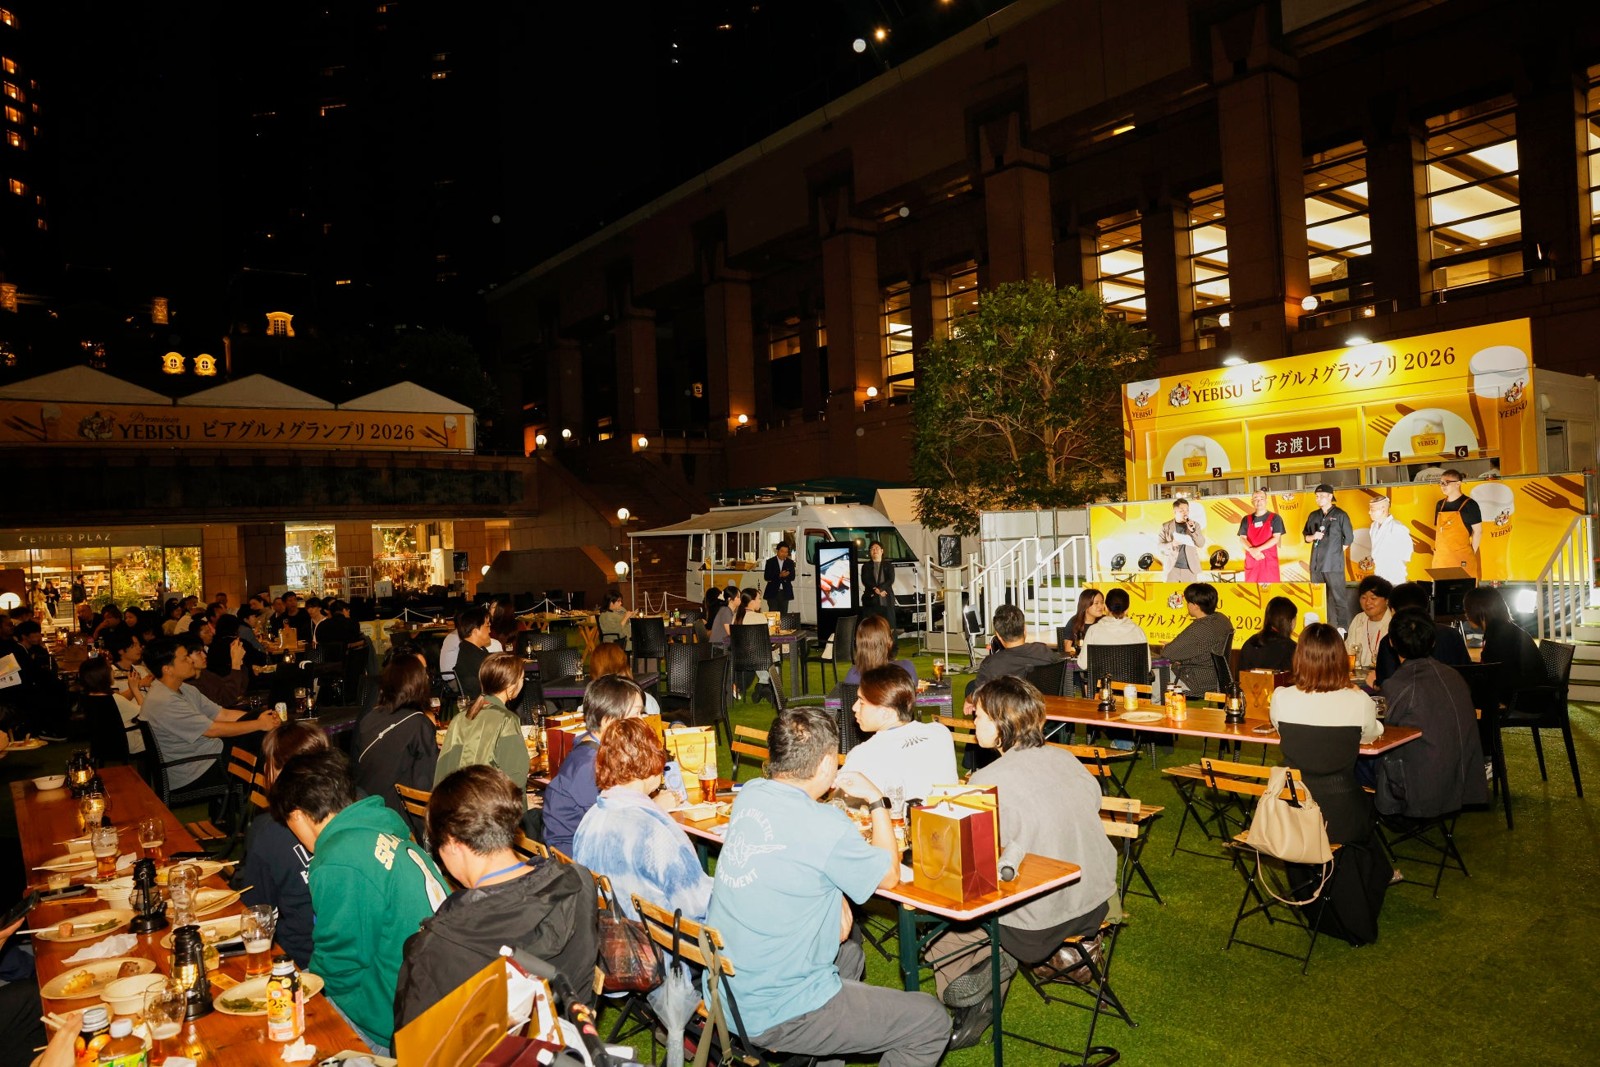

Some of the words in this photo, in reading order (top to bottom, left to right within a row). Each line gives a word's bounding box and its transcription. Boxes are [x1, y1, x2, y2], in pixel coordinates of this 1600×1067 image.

[1193, 383, 1243, 403] YEBISU
[1251, 354, 1397, 393] ビアグルメグランプリ
[1404, 347, 1455, 371] 2026
[1498, 399, 1528, 418] YEBISU
[130, 412, 180, 424] Premium
[118, 423, 190, 440] YEBISU
[203, 419, 365, 441] ビアグルメグランプリ
[370, 423, 415, 440] 2026
[1274, 434, 1331, 455] お渡し口
[1416, 439, 1439, 447] YEBISU
[1458, 447, 1466, 456] 6
[1391, 453, 1398, 462] 5
[1272, 463, 1279, 472] 3
[1326, 459, 1333, 468] 4
[1167, 472, 1174, 481] 1
[1213, 468, 1221, 477] 2
[19, 534, 73, 544] CENTER
[1236, 615, 1263, 630] 202
